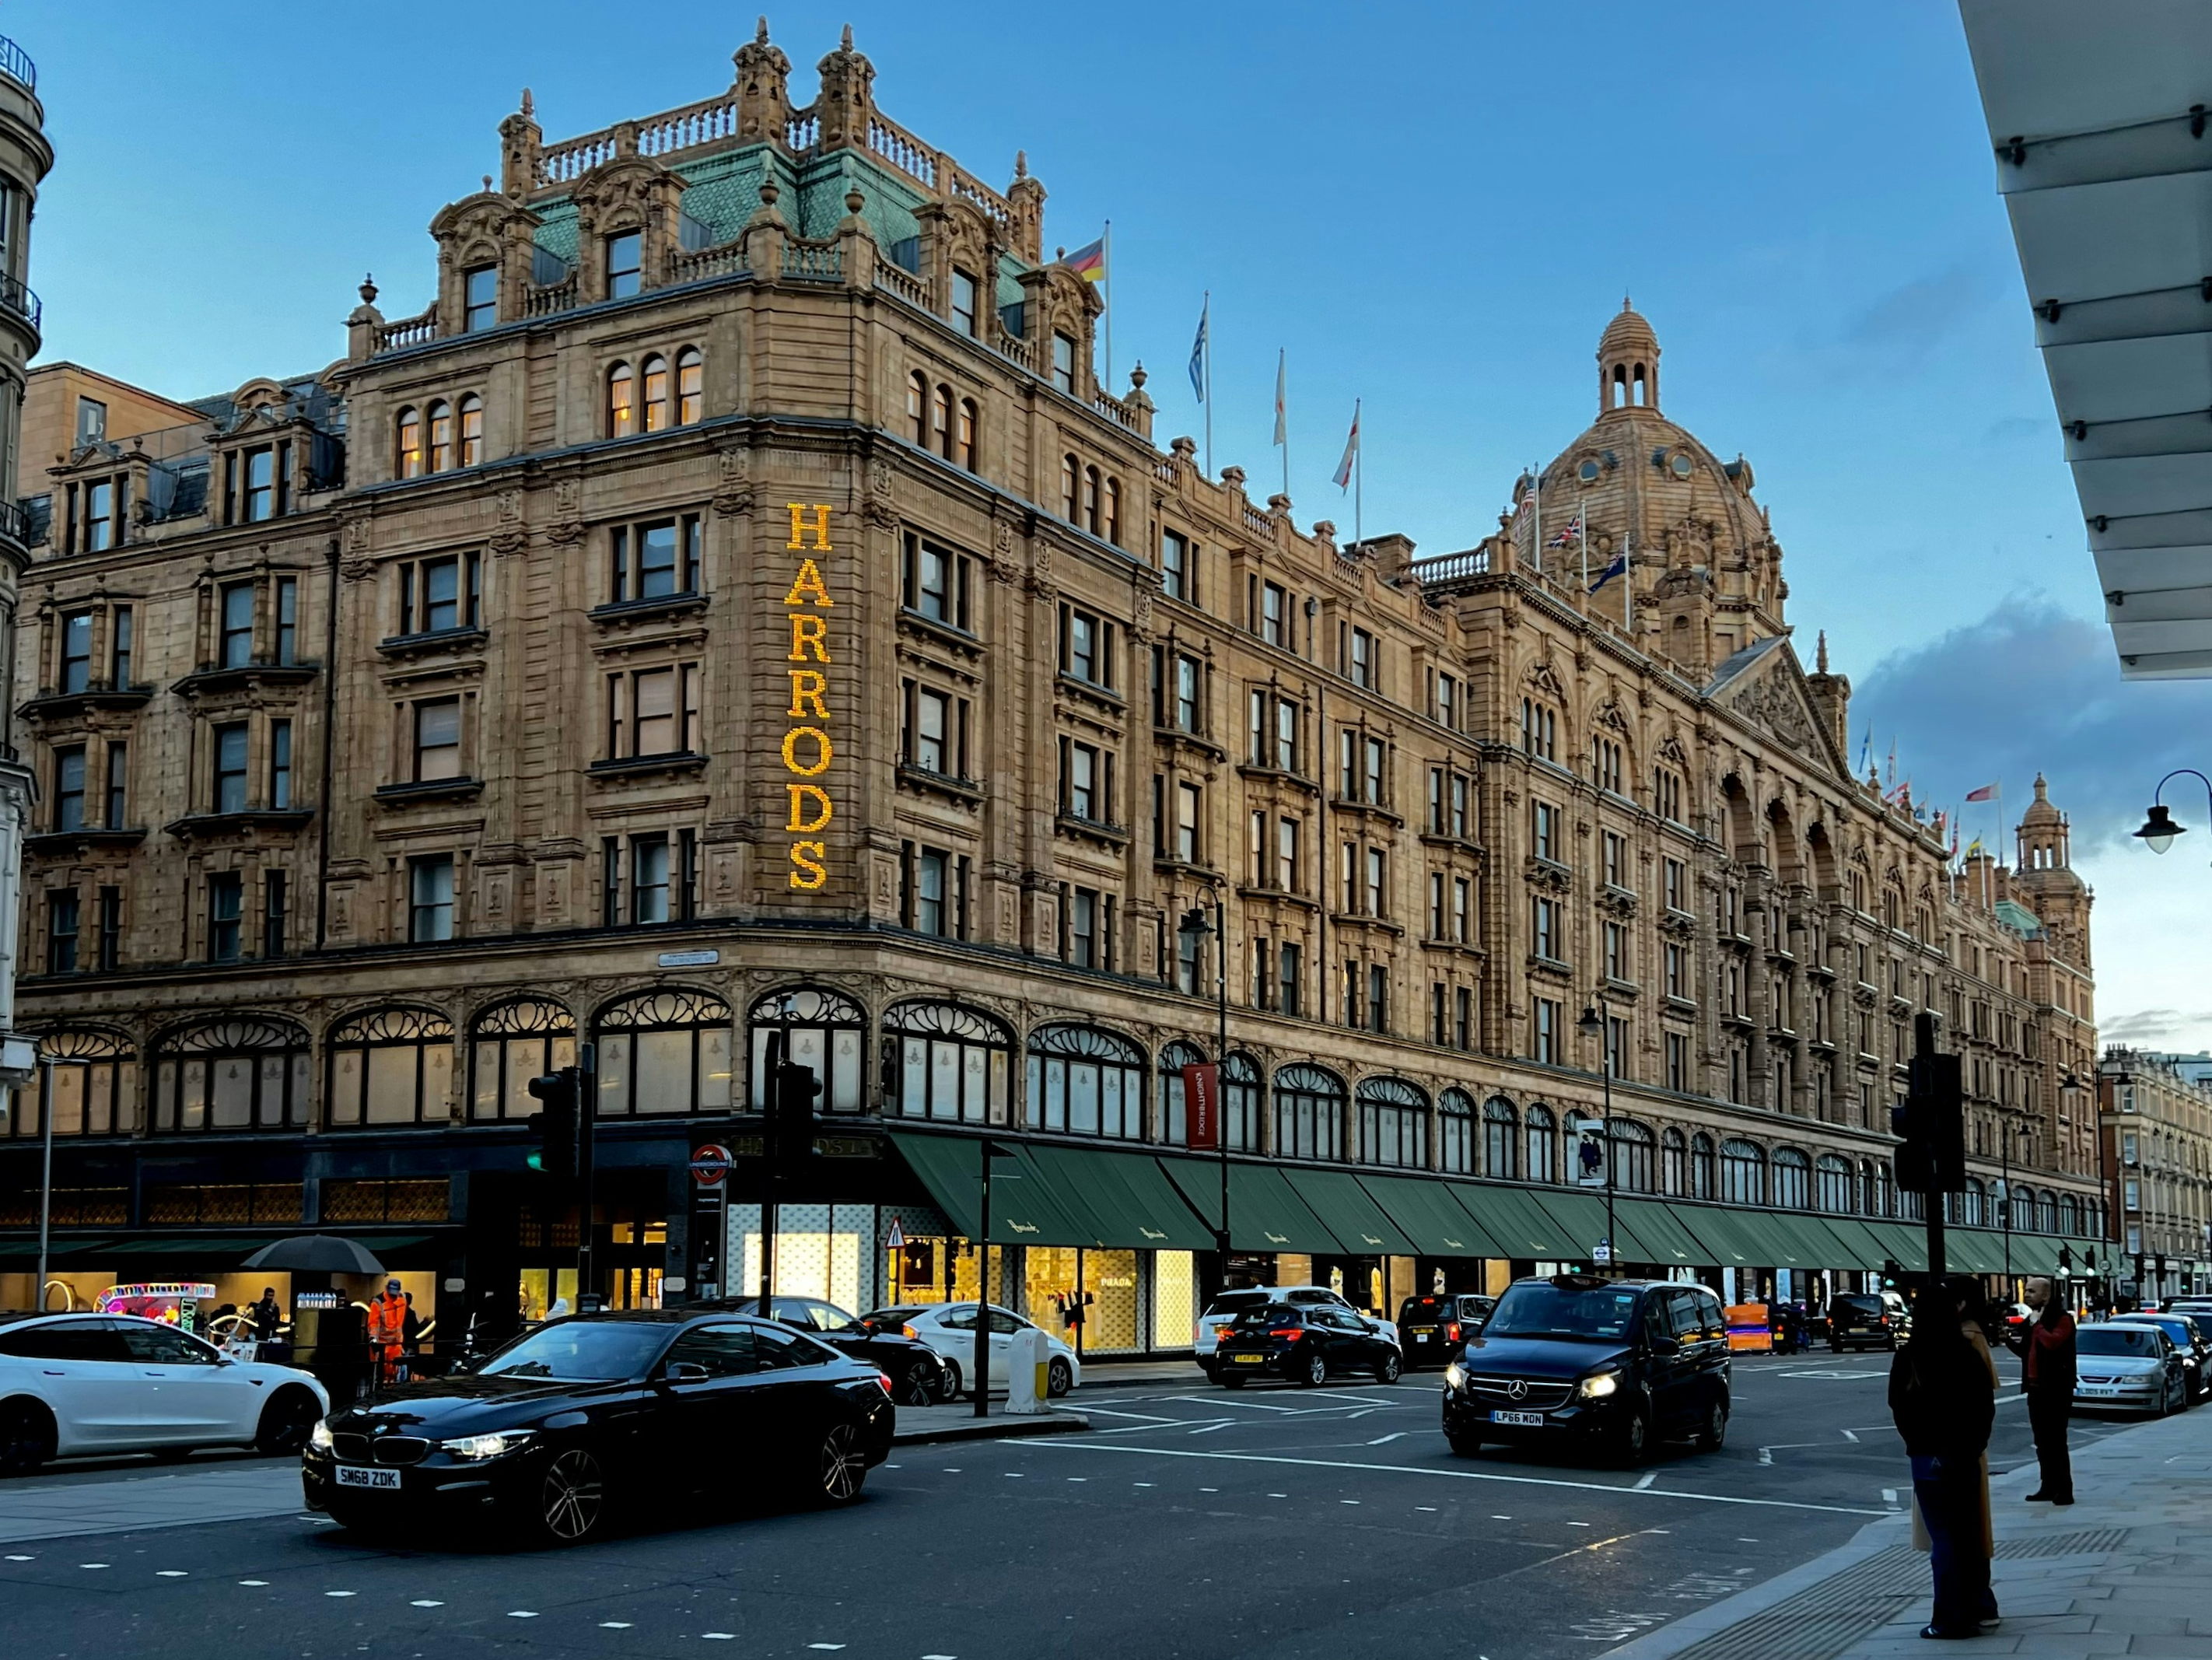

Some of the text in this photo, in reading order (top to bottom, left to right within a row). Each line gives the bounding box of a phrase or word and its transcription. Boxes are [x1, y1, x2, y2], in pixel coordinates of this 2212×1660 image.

[782, 503, 834, 889] HARRODS
[1496, 1412, 1521, 1423] LP66
[341, 1469, 396, 1487] SM68 ZDK
